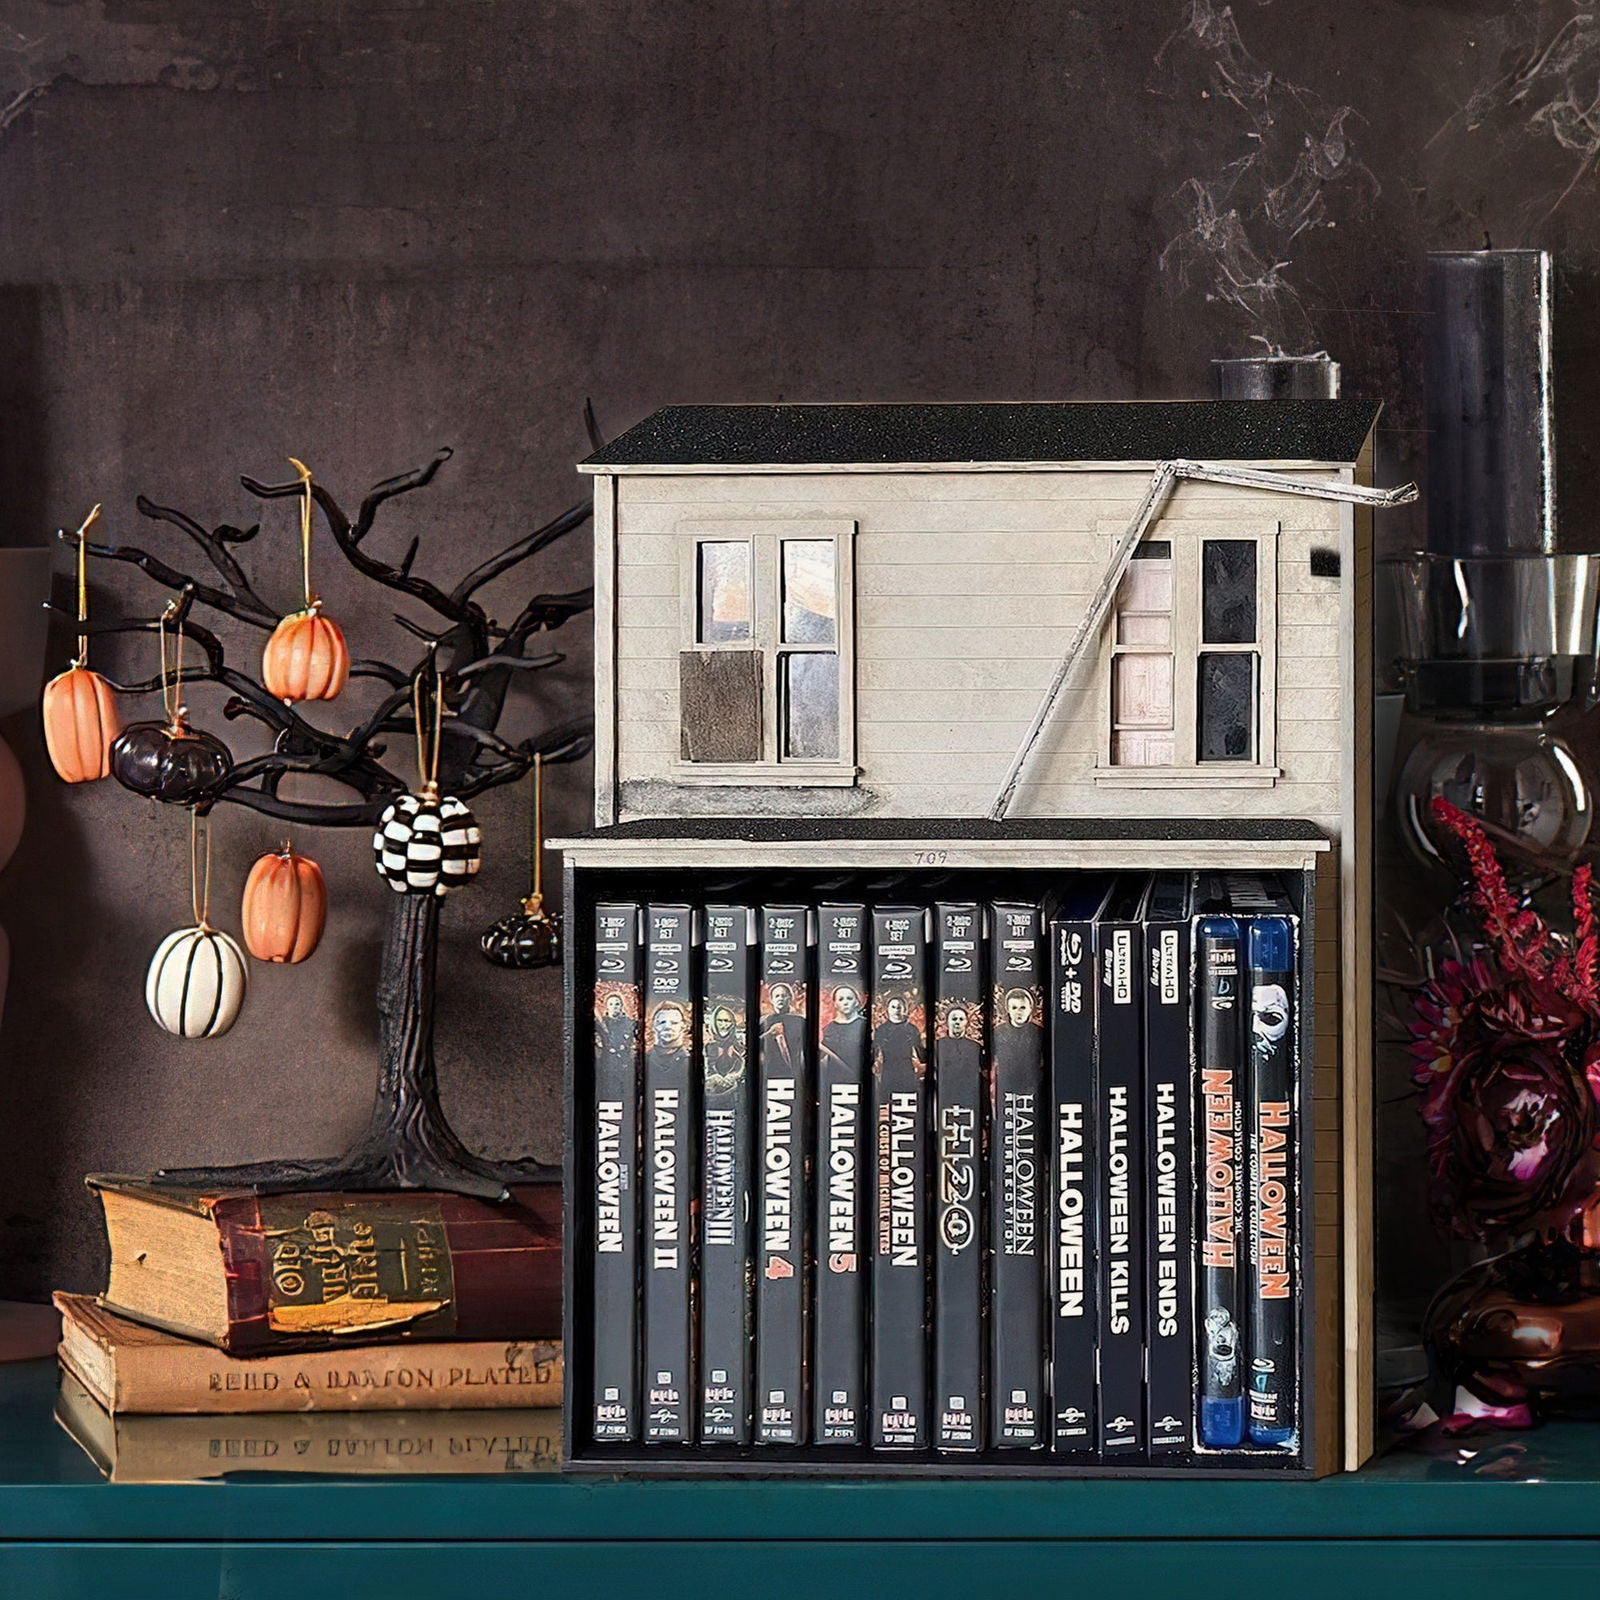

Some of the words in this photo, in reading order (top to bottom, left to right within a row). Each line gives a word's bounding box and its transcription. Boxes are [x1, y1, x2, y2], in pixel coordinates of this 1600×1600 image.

[914, 849, 947, 865] 709
[1070, 982, 1082, 1014] DVD
[598, 1101, 623, 1253] HALLOWEEN
[653, 1089, 679, 1241] HALLOWEEN
[705, 1220, 735, 1245] III
[706, 1109, 735, 1221] HALLOWEEN
[764, 1078, 795, 1251] HALLOWEEN
[829, 1083, 859, 1251] HALLOWEEN
[891, 1092, 918, 1267] HALLOWEEN
[1015, 1093, 1035, 1256] HALLOWEEN
[1059, 1103, 1084, 1318] HALLOWEEN
[1109, 1086, 1129, 1254] HALLOWEEN
[1156, 1083, 1177, 1253] HALLOWEEN
[1202, 1068, 1235, 1268] HALLOWEEN
[1259, 1101, 1291, 1300] HALLOWEEN
[653, 1247, 679, 1270] II
[764, 1254, 795, 1280] 4
[828, 1253, 857, 1274] 5
[1110, 1260, 1129, 1335] KILLS
[1158, 1259, 1178, 1337] ENDS
